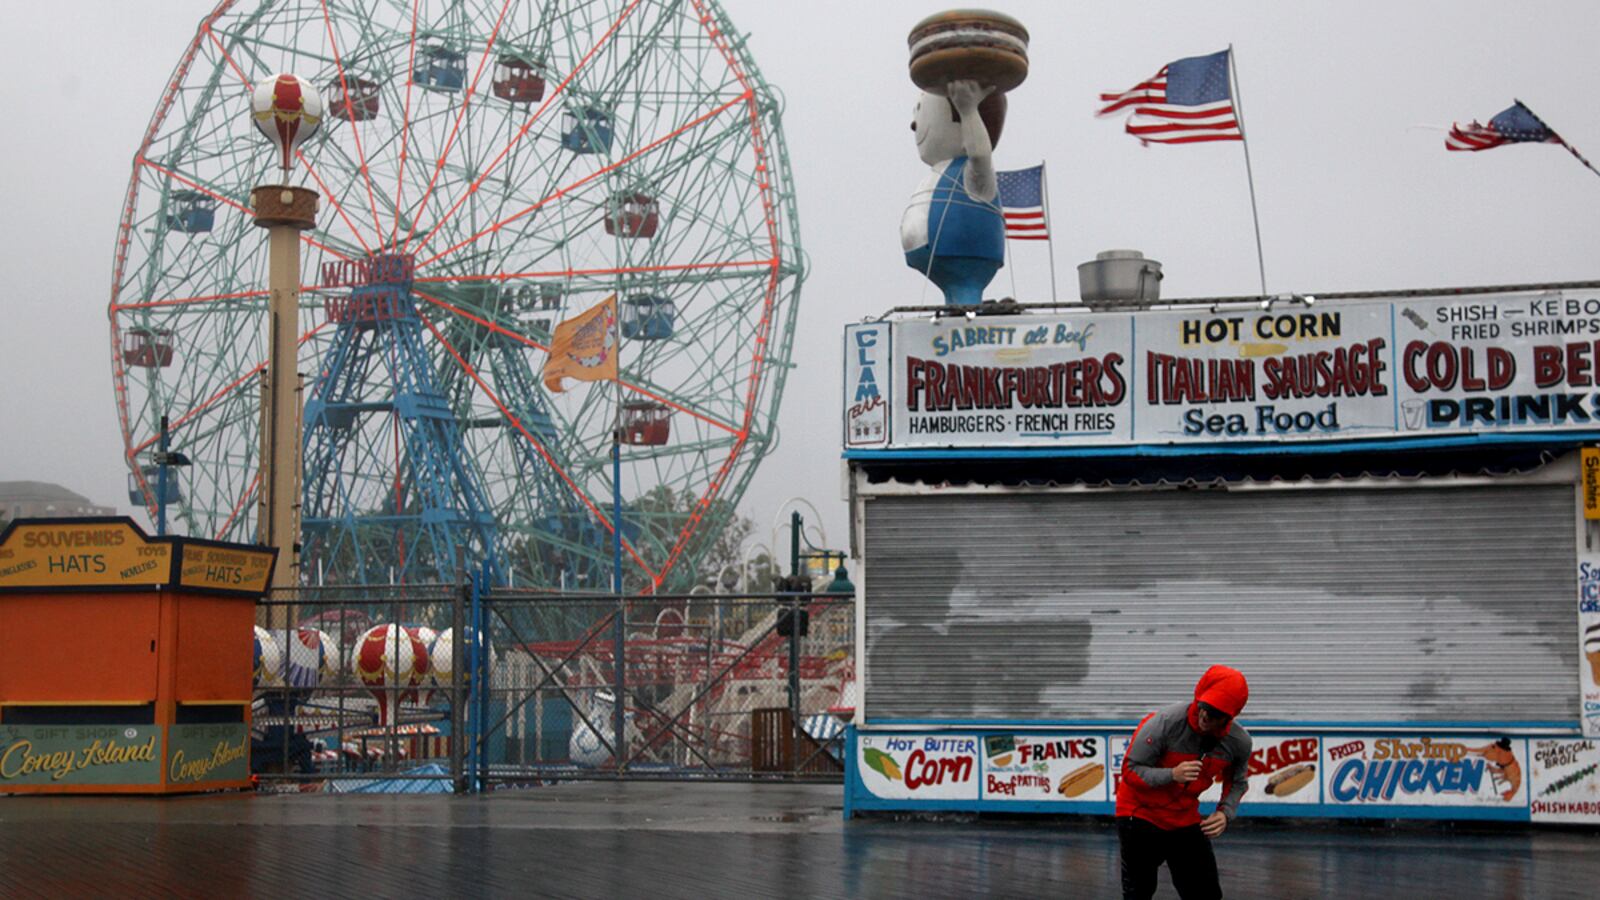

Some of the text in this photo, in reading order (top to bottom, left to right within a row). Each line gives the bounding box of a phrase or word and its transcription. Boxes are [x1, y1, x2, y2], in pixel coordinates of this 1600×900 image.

[322, 254, 415, 288] WONDER
[324, 290, 406, 323] WHEEL
[1436, 305, 1497, 323] SHISH
[932, 327, 1016, 356] SABRETT
[1053, 323, 1095, 351] Beef
[1182, 312, 1341, 344] HOT CORN
[1451, 318, 1600, 341] FRIED SHRIMPS
[855, 329, 878, 402] CLAM
[1147, 337, 1388, 405] ITALIAN SAUSAGE
[1403, 340, 1516, 393] COLD
[907, 352, 1126, 411] FRANKFURTERS
[909, 412, 1115, 434] HAMBURGERS FRENCH FRIES
[1183, 402, 1340, 436] Sea Food
[23, 530, 125, 548] SOUVENIRS
[136, 546, 167, 557] TOYS
[48, 554, 106, 574] HATS
[119, 560, 157, 580] NOVELTIES
[206, 565, 242, 584] HATS
[1580, 561, 1600, 580] So
[1581, 584, 1600, 600] IC
[34, 728, 118, 740] GIFT SHOP
[886, 737, 917, 751] HOT
[924, 737, 976, 755] BUTTER
[0, 735, 157, 781] Coney Island
[170, 735, 248, 781] Coney Island
[1017, 738, 1097, 764] FRANKS
[1248, 738, 1318, 777] SAGE
[1328, 740, 1365, 760] FRIED
[1373, 737, 1467, 762] Shrimp
[1535, 740, 1596, 761] CHARCOAL
[1544, 752, 1578, 769] BROIL
[904, 748, 973, 790] Corn
[1329, 758, 1484, 802] CHICKEN
[987, 774, 1016, 796] Beef
[1531, 799, 1600, 815] SHISH KABO
